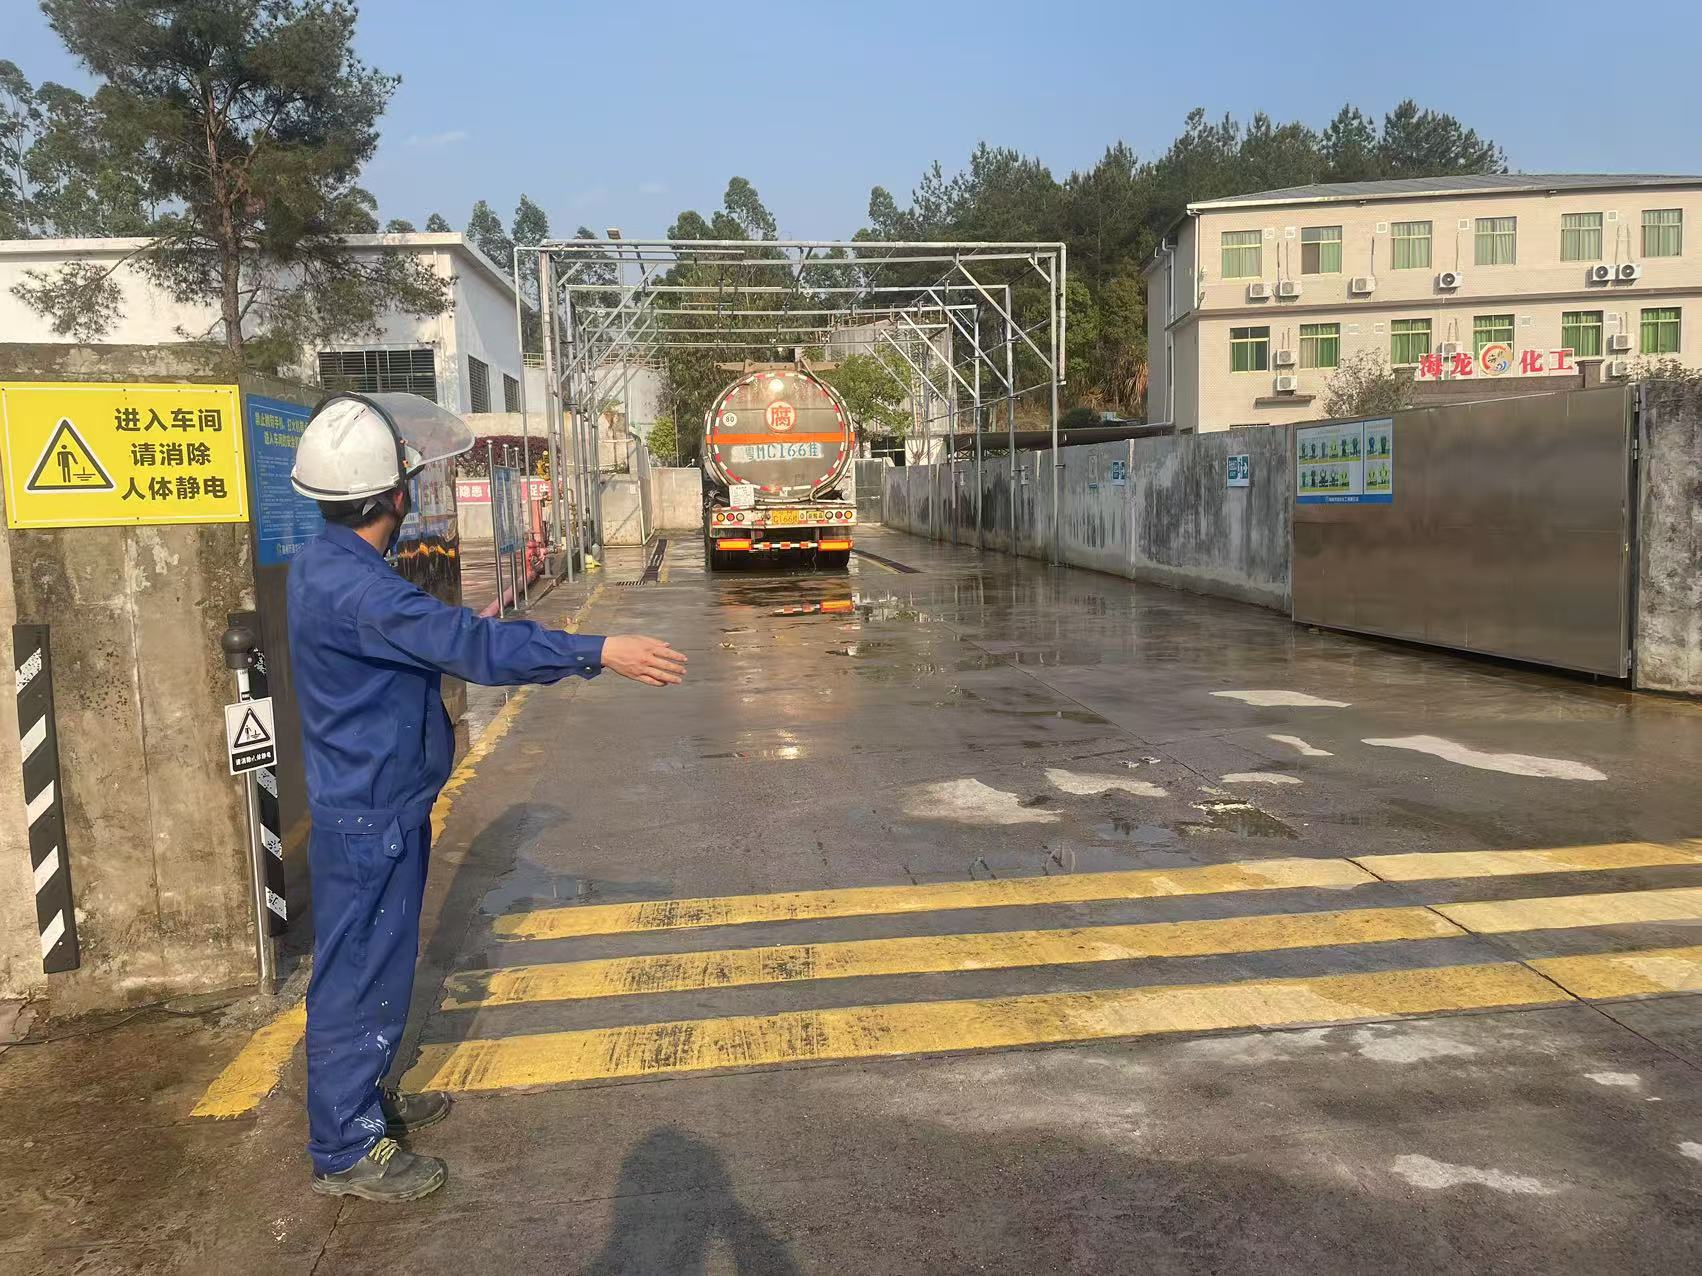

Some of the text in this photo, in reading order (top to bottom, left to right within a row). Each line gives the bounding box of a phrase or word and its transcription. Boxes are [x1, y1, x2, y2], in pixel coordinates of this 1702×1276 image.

[1419, 352, 1474, 378] 海龙
[1518, 349, 1574, 375] 化工
[114, 408, 222, 432] 进入车间
[726, 415, 735, 423] 80
[772, 405, 791, 427] 腐
[131, 442, 212, 467] 请消除
[121, 476, 228, 500] 人体静电
[456, 484, 483, 499] 隐患
